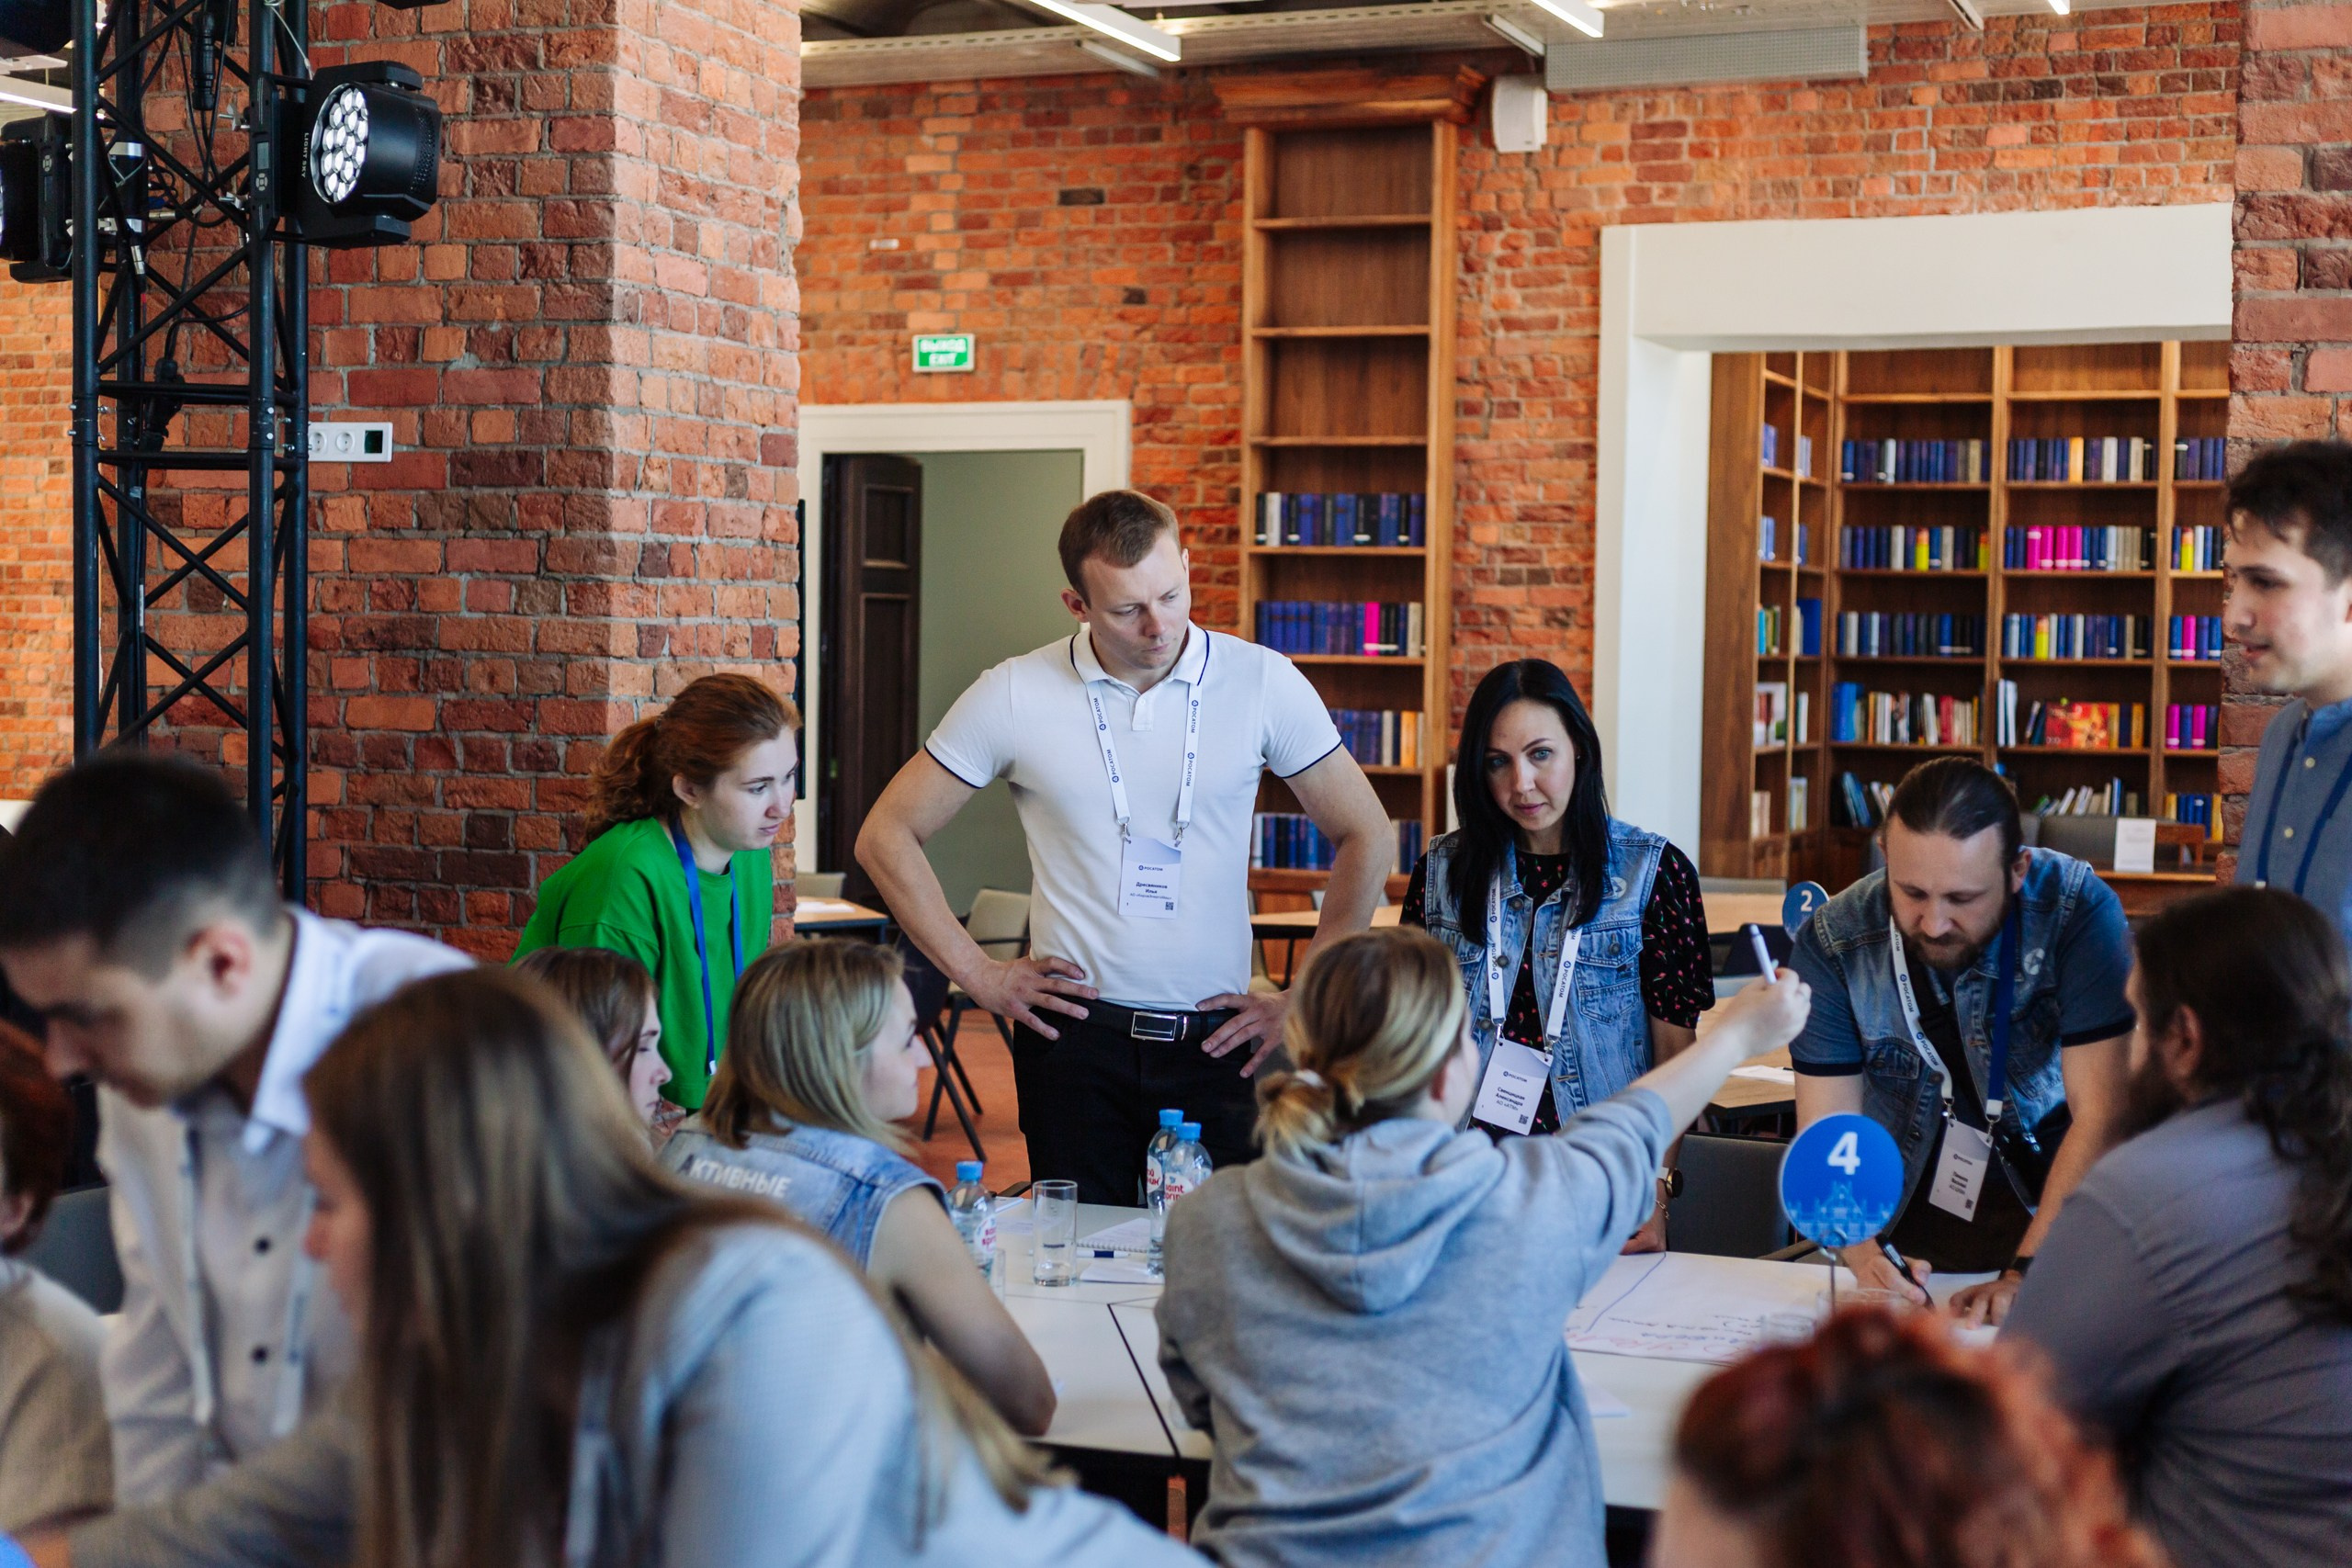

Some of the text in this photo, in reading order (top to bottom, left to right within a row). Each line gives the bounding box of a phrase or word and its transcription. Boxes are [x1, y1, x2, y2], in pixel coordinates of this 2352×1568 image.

[929, 353, 957, 367] EXIT
[1093, 697, 1104, 724] РОСАТОМ
[1106, 749, 1117, 775] РОСАТОМ
[1185, 760, 1193, 787] РОСАТОМ
[1801, 889, 1813, 912] 2
[1559, 969, 1568, 998] РОСАТОМ
[1903, 983, 1914, 1013] РОСАТОМ
[1921, 1040, 1939, 1066] РОСАТОМ
[1509, 1073, 1528, 1082] РОСАТОМ
[1827, 1131, 1861, 1176] 4
[678, 1154, 792, 1199] АКТИВНЫЕ
